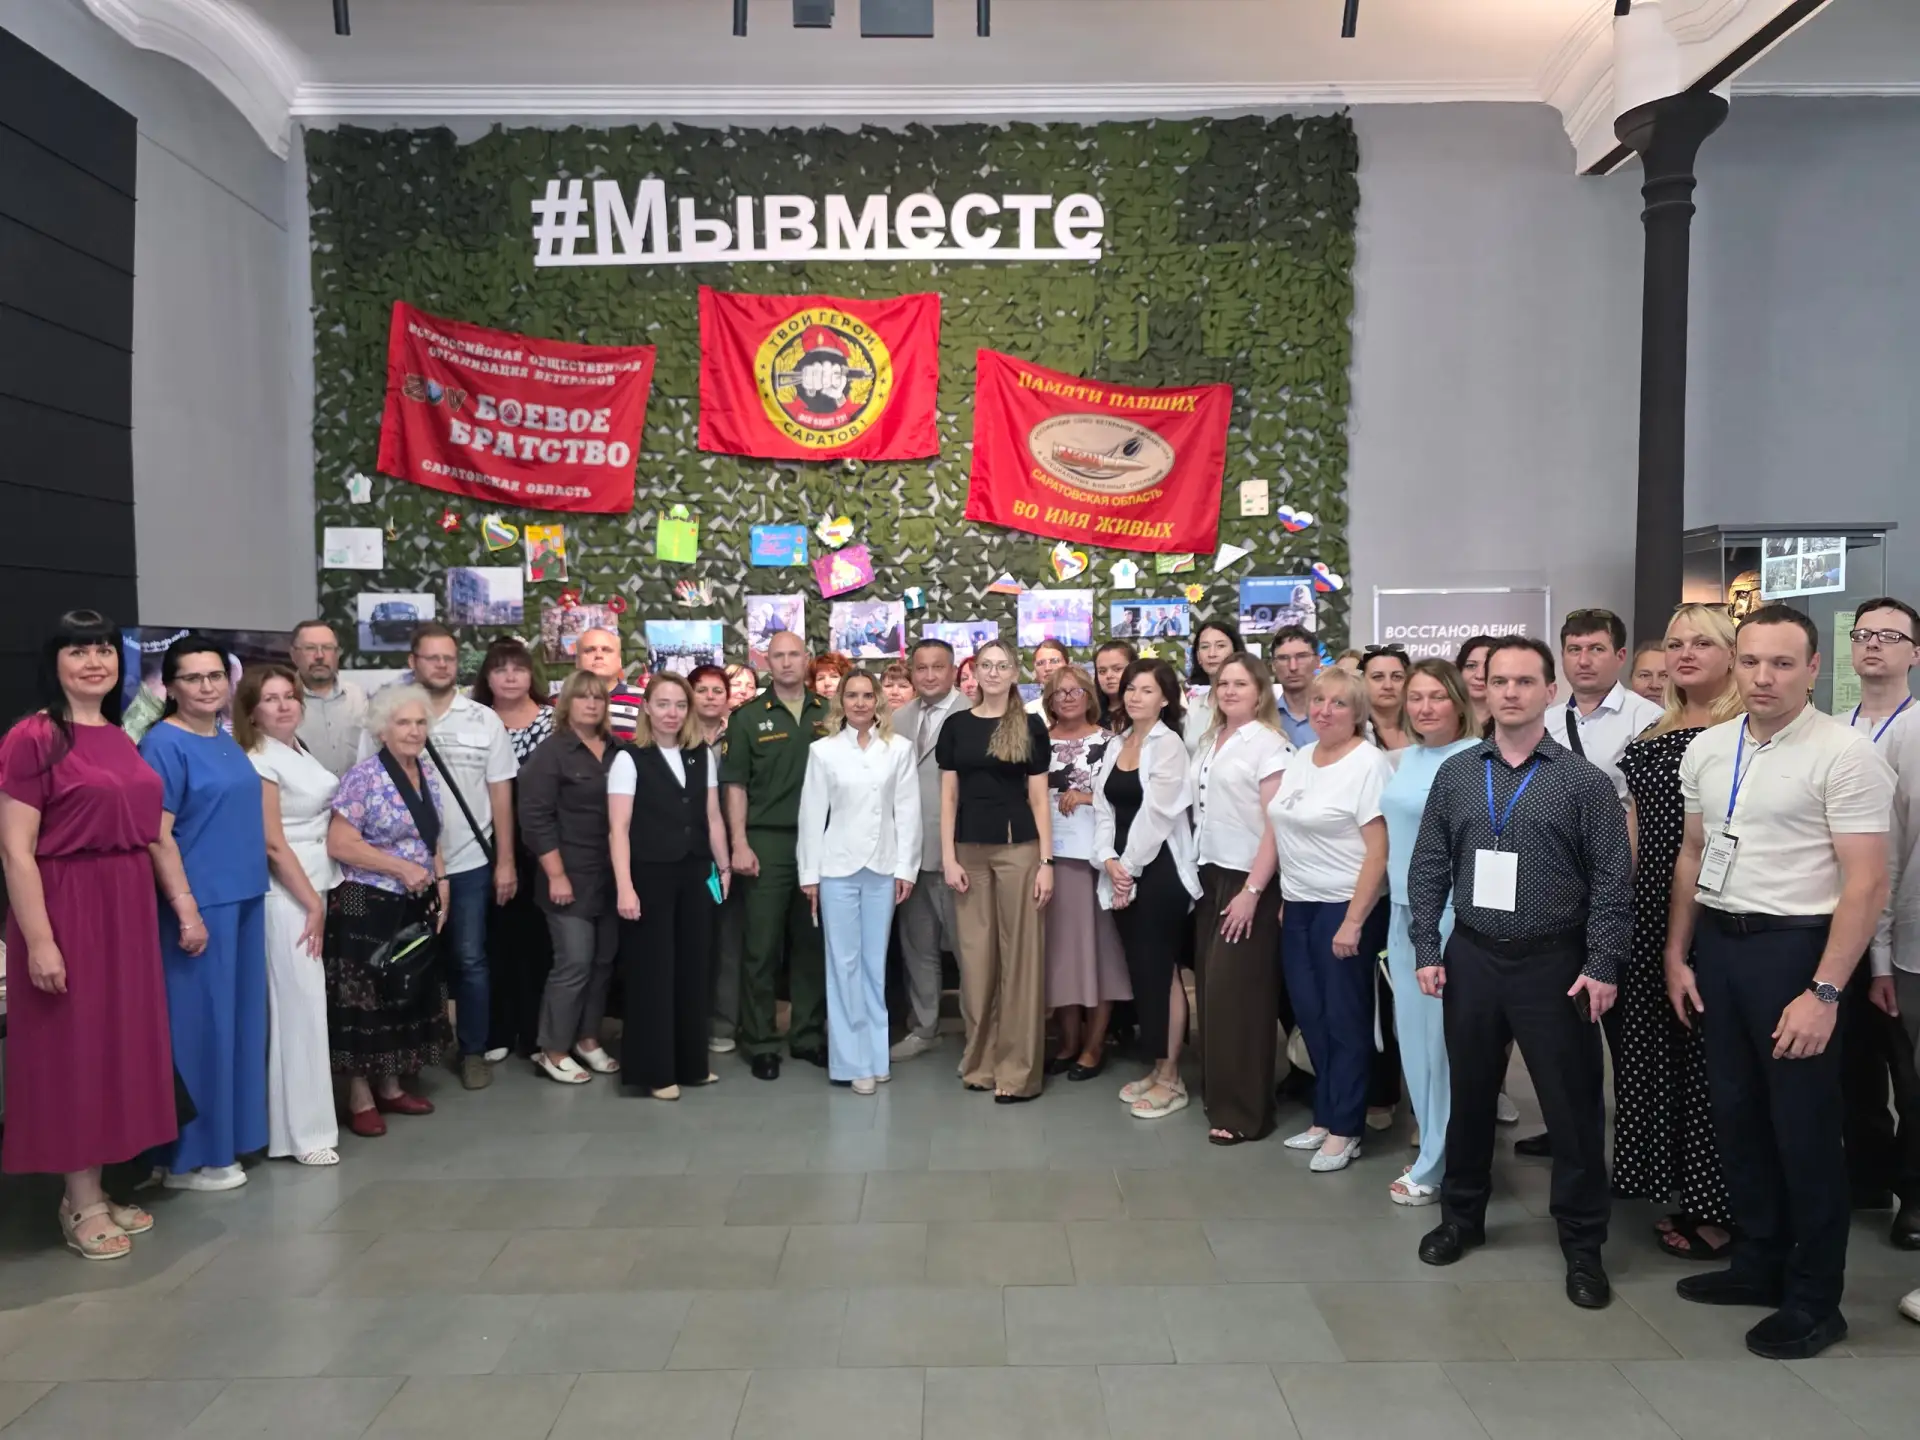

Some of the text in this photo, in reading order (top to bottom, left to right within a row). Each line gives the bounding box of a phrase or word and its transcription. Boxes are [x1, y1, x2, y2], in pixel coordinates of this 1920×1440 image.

[531, 178, 1105, 259] #Мывместе
[408, 321, 642, 374] ВСЕРОССИЙСКАЯ ОБЩЕСТВЕННАЯ
[768, 314, 813, 348] ТВОИ
[428, 346, 616, 386] ОРГАНИЗАЦИЯ ВЕТЕРАНОВ
[1017, 370, 1199, 413] ПАМЯТИ ПАВШИХ
[474, 394, 611, 433] БОЕВОЕ
[449, 417, 630, 468] БРАТСТВО
[421, 458, 592, 498] САРАТОВСКАЯ ОБЛАСТЬ
[1031, 468, 1164, 506] САРАТОВСКАЯ ОБЛАСТЬ
[1013, 499, 1176, 539] ВО ИМЯ ЖИВЫХ
[1384, 623, 1527, 639] ВОССТАНОВЛЕНИЕ
